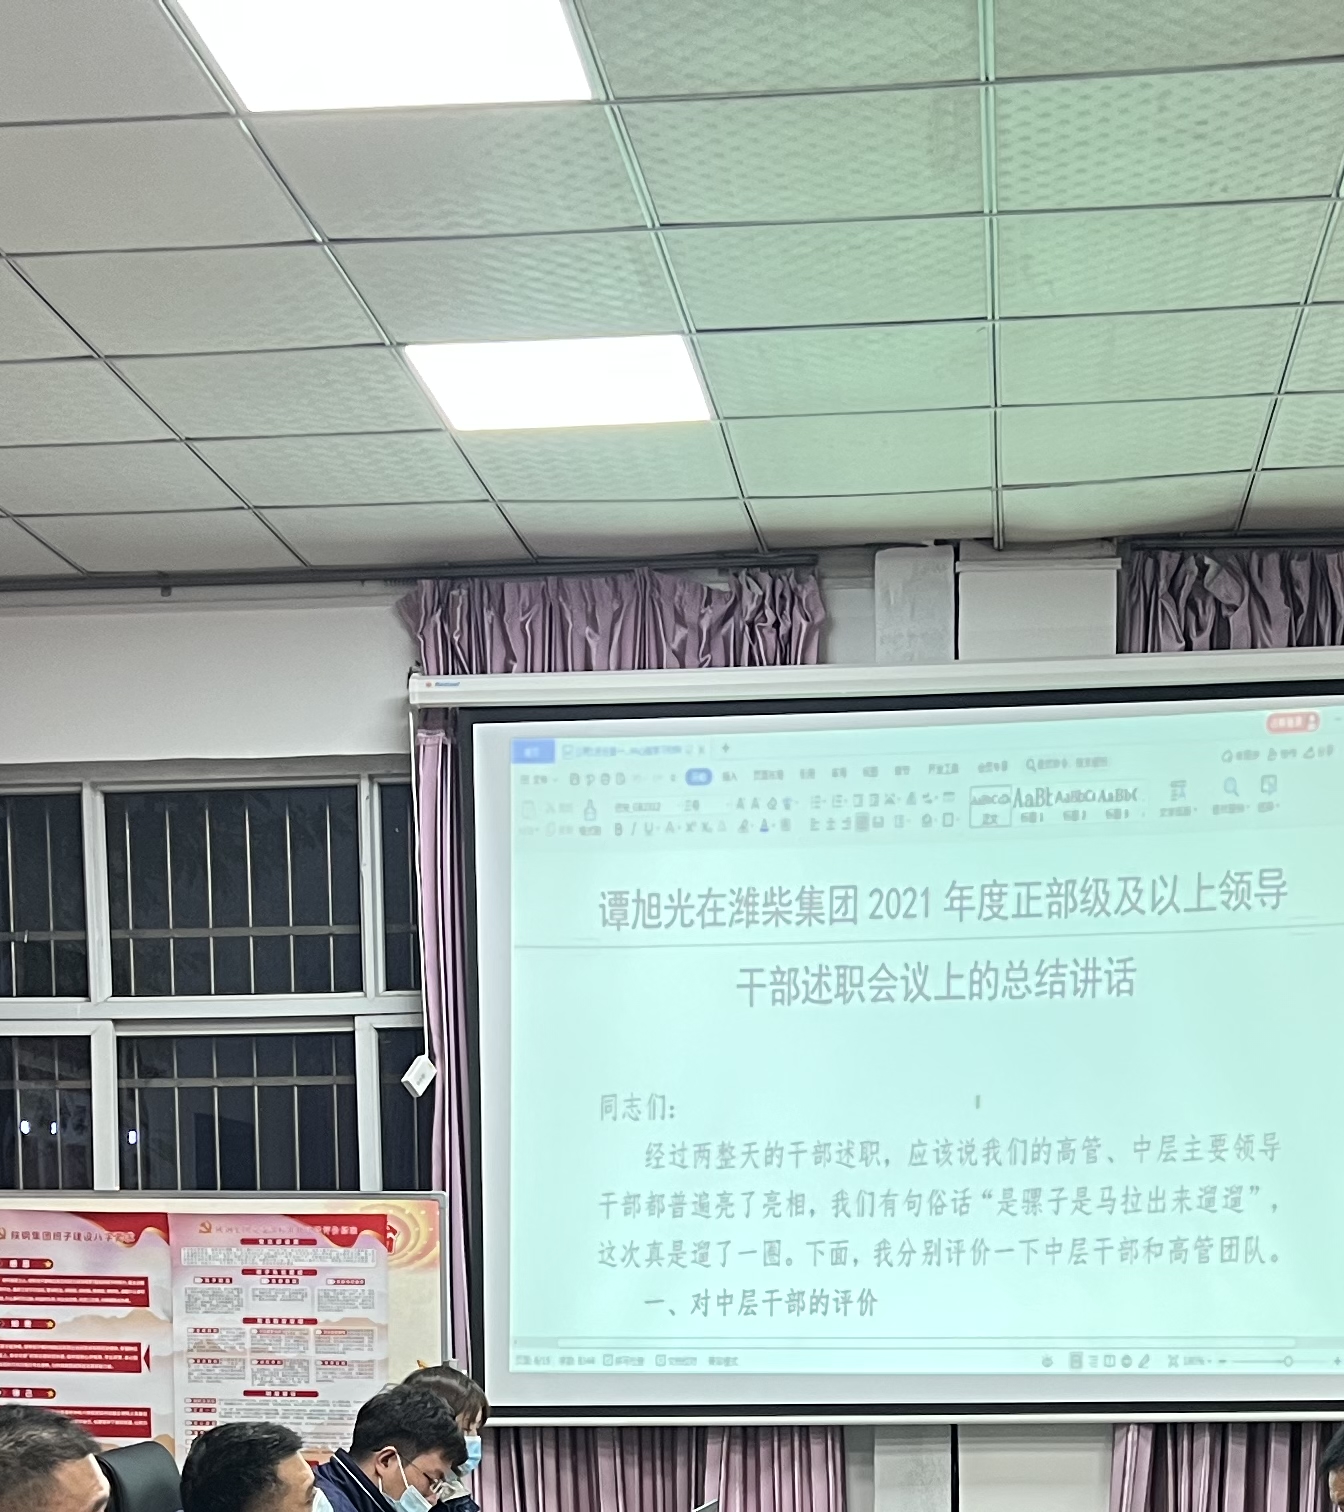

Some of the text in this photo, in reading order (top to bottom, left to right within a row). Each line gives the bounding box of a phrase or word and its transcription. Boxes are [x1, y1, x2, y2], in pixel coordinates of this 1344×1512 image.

[598, 868, 1288, 931] 谭旭光在潍柴集团 2021 年度正部级及以上领导
[736, 957, 1137, 1007] 干部述职会议上的总结讲话
[644, 1288, 879, 1317] 一、对中层干部的评价
